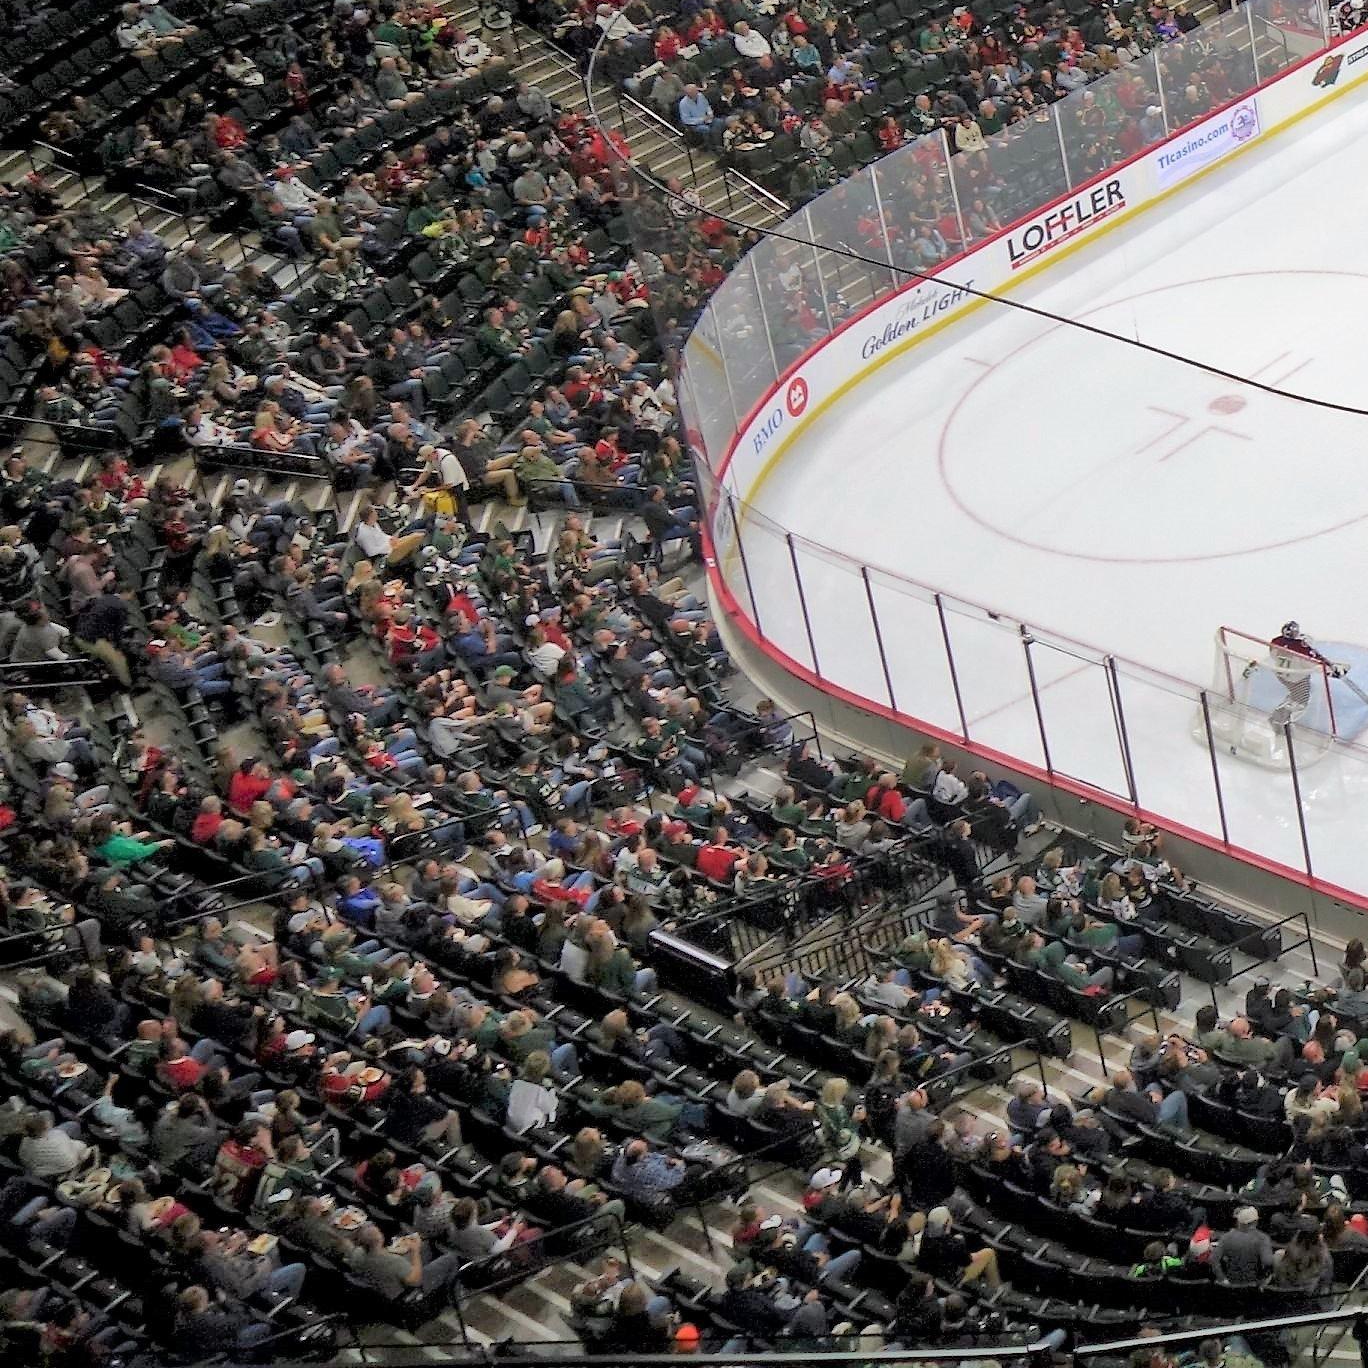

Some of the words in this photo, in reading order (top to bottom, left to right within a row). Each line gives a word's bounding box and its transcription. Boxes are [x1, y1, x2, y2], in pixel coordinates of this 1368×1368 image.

[1008, 180, 1124, 262] LOFFLER
[923, 280, 975, 321] LIGHT
[753, 408, 784, 454] BMO
